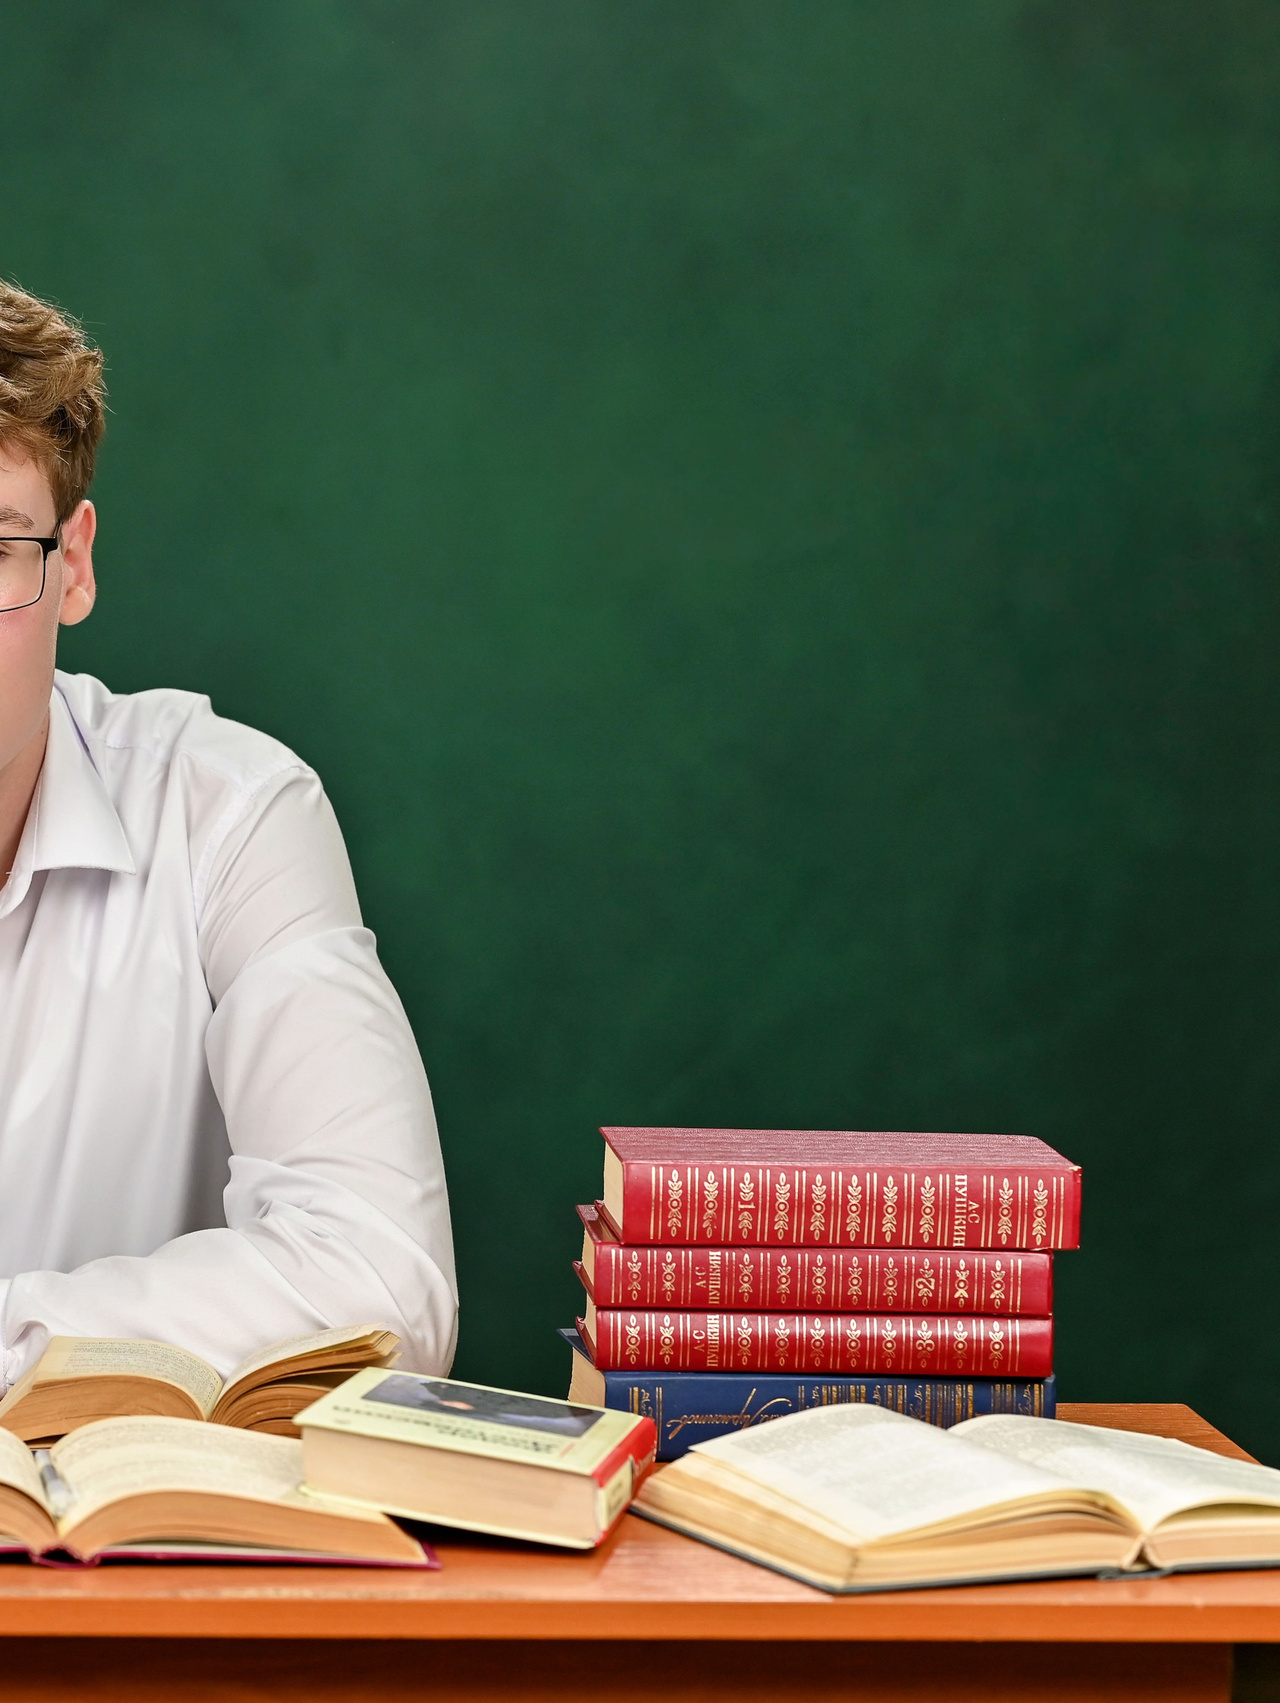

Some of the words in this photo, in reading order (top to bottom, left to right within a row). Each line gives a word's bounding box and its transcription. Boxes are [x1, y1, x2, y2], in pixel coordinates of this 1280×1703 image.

[952, 1174, 968, 1247] ПУШКИН
[708, 1250, 722, 1305] ПУШКИН
[915, 1277, 936, 1291] 2
[706, 1314, 720, 1367] ПУШКИН
[915, 1339, 935, 1352] 3
